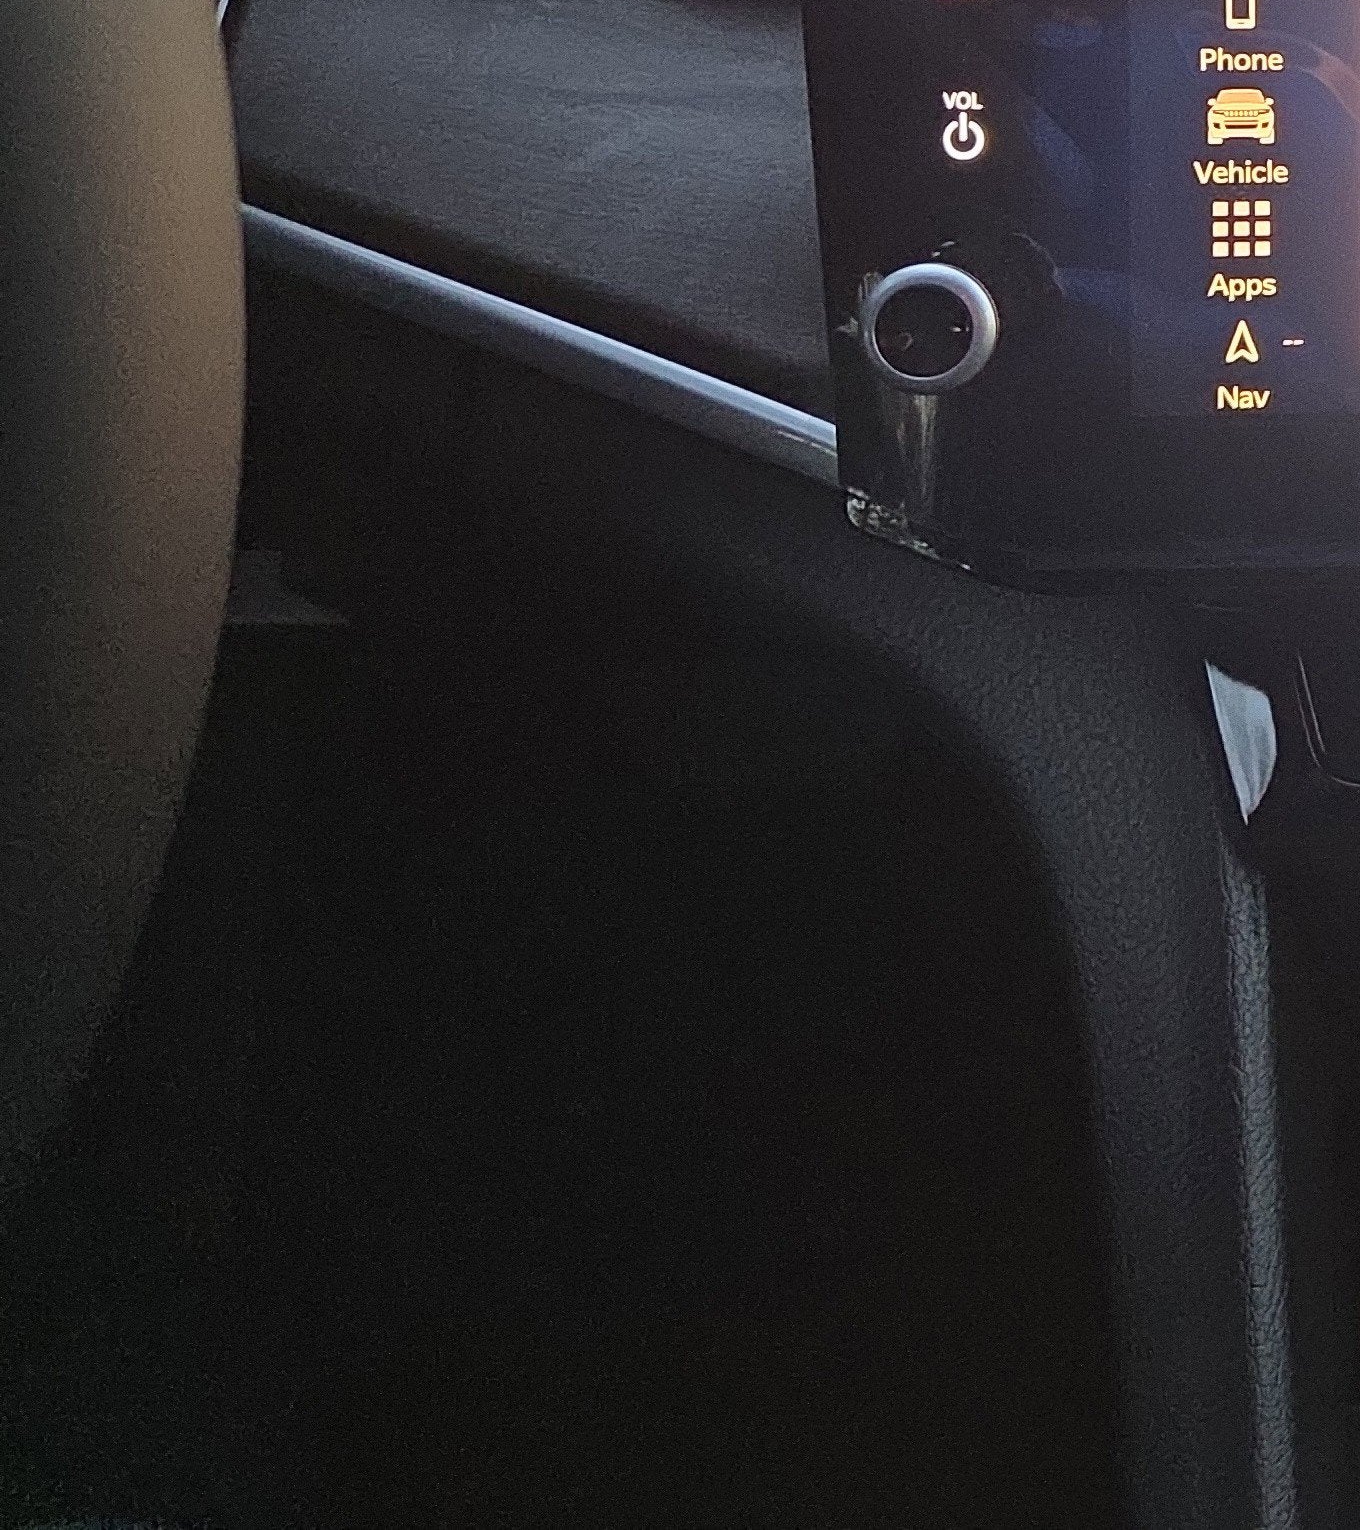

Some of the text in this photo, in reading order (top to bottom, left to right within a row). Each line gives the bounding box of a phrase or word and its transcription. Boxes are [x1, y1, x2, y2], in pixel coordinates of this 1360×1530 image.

[1198, 47, 1284, 73] Phone
[942, 91, 984, 111] VOL
[1192, 159, 1290, 186] Vehicle
[1207, 273, 1278, 304] Apps
[1216, 385, 1272, 411] Nav
